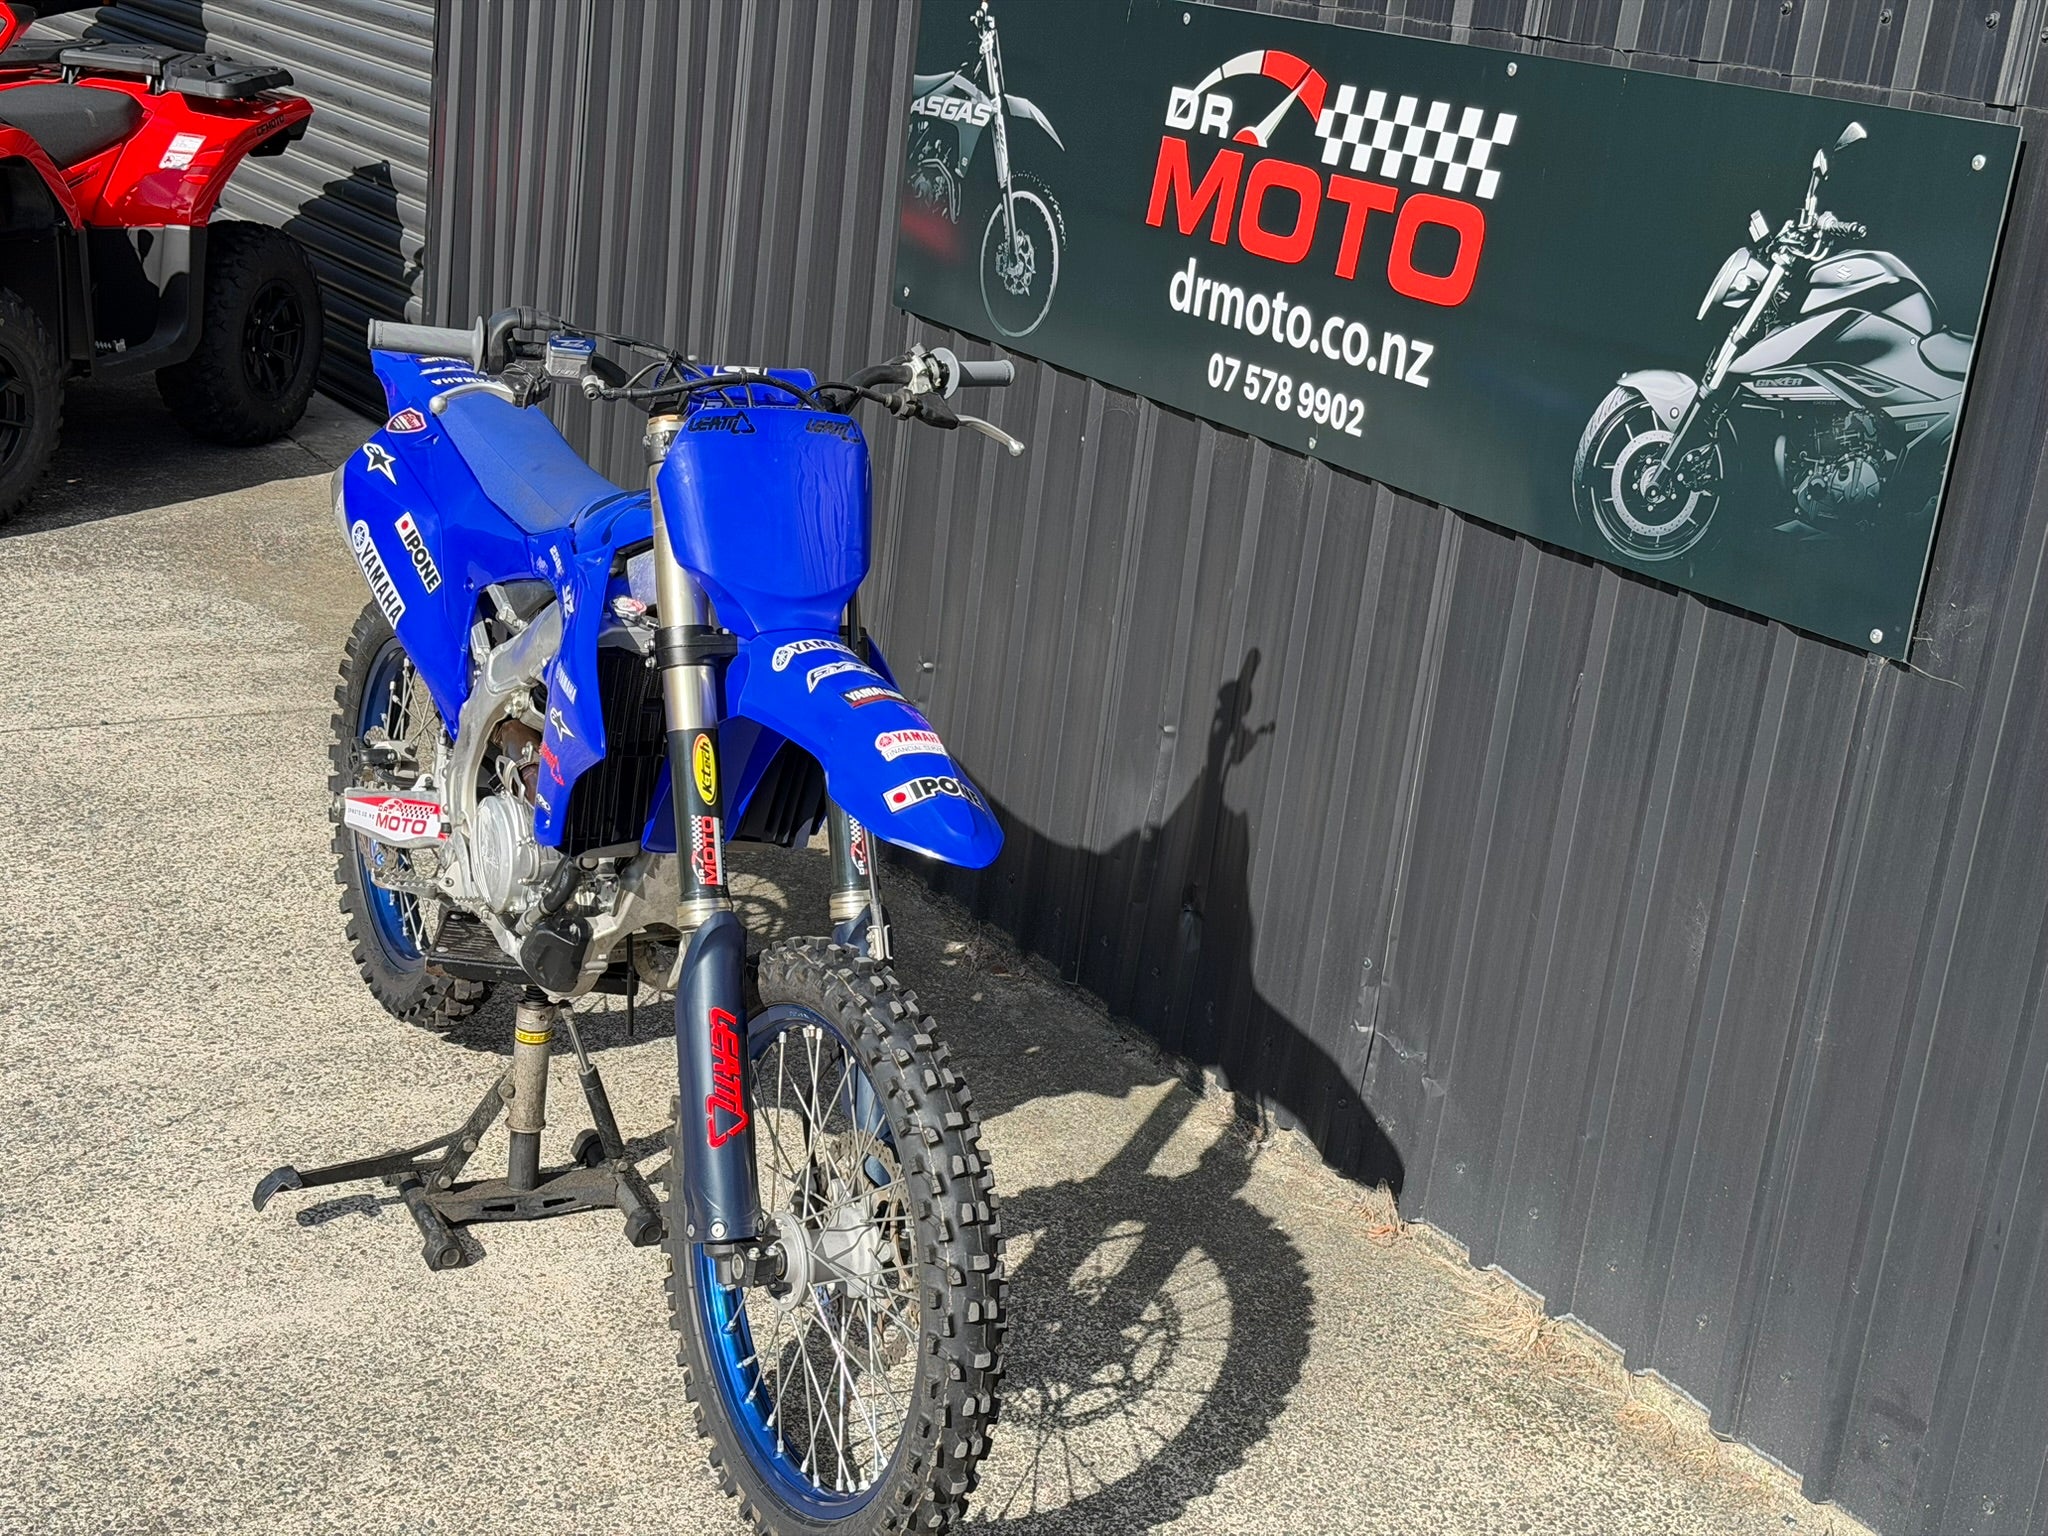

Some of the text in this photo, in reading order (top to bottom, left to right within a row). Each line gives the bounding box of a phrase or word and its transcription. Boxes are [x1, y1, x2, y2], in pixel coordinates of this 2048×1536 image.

[1164, 86, 1233, 139] DR
[1146, 136, 1486, 307] MOTO
[1169, 257, 1435, 389] drmoto.co.nz
[1208, 353, 1366, 438] 07 578 9902
[361, 541, 403, 626] YAMAHA
[404, 529, 440, 591] IPONE
[789, 641, 854, 655] YAMA
[375, 813, 427, 835] MOTO
[701, 816, 719, 886] MOTO
